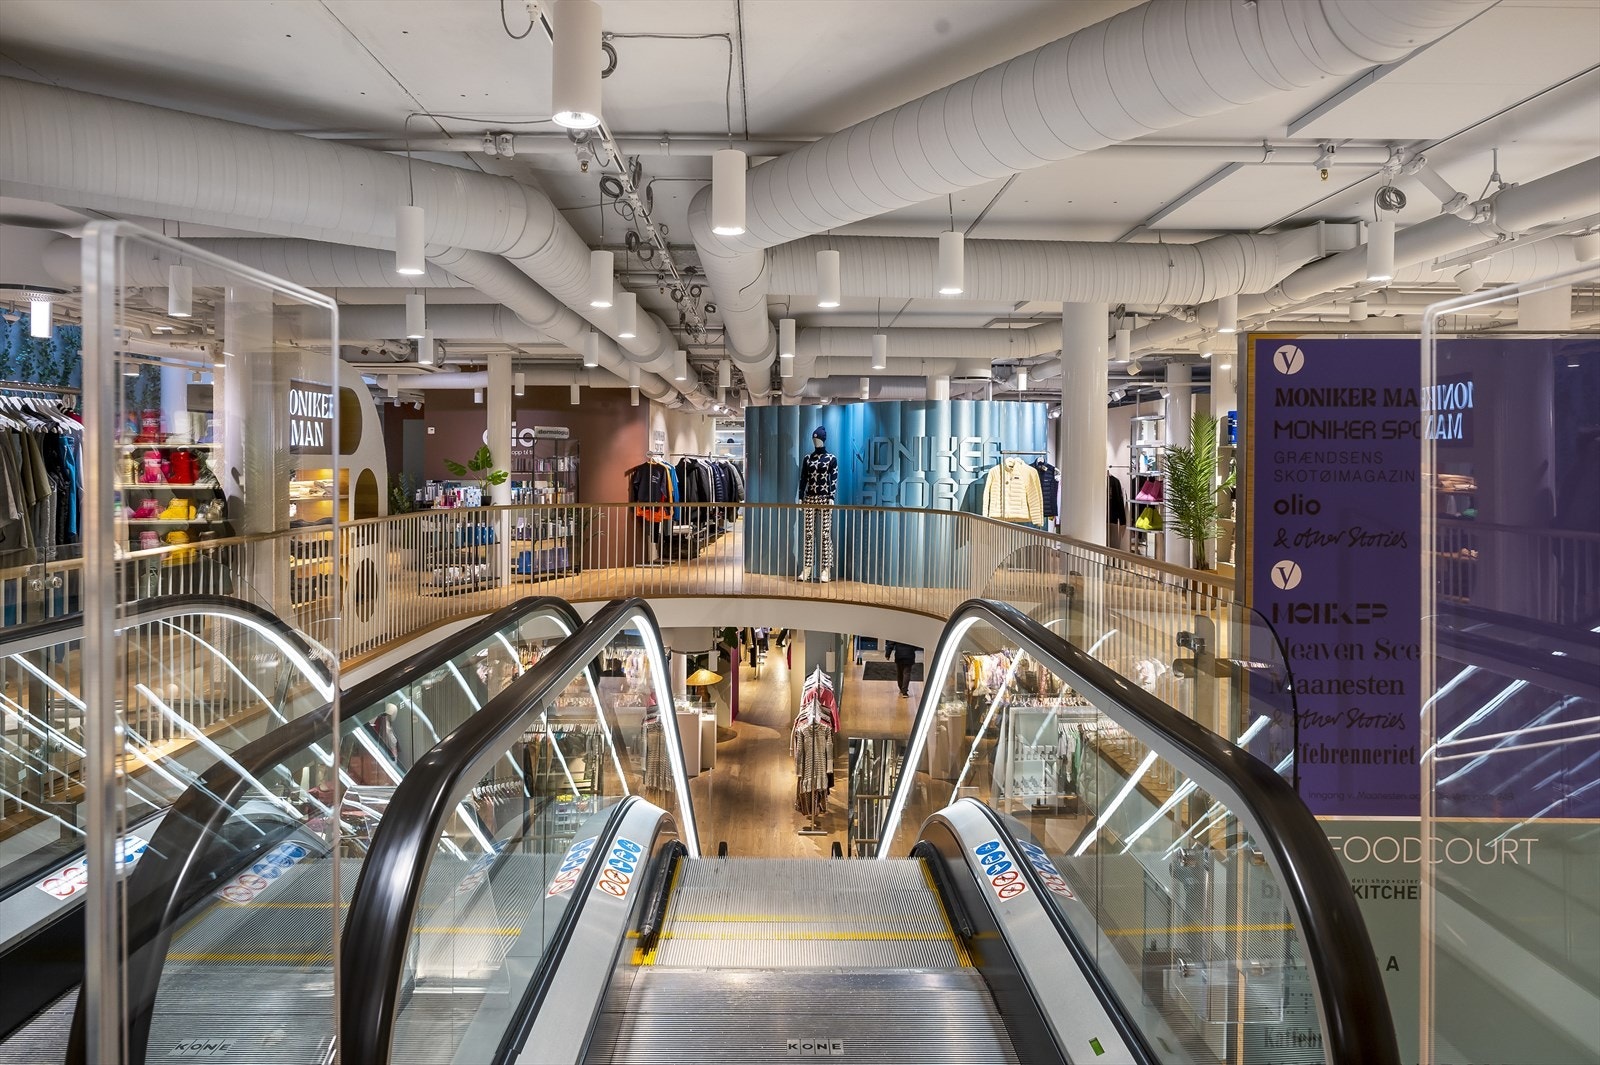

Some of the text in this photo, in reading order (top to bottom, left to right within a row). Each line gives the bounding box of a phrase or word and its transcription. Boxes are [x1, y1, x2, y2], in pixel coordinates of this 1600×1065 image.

[289, 388, 335, 419] ONIKE
[1274, 387, 1420, 408] MONIKER MA
[290, 419, 324, 447] MAN
[1274, 420, 1421, 440] MONIKER SPO
[852, 436, 1001, 473] MONIKER
[1273, 450, 1384, 465] GRÆNDSENS
[1273, 469, 1415, 483] SKOTØIMAGAZIN
[1273, 493, 1322, 516] olio
[1273, 526, 1408, 549] & other Stories
[1373, 636, 1421, 661] Sce
[1269, 672, 1406, 696] Maanesten
[1345, 707, 1407, 730] Stories
[1351, 885, 1421, 900] KITCHE
[175, 1043, 232, 1051] KONE
